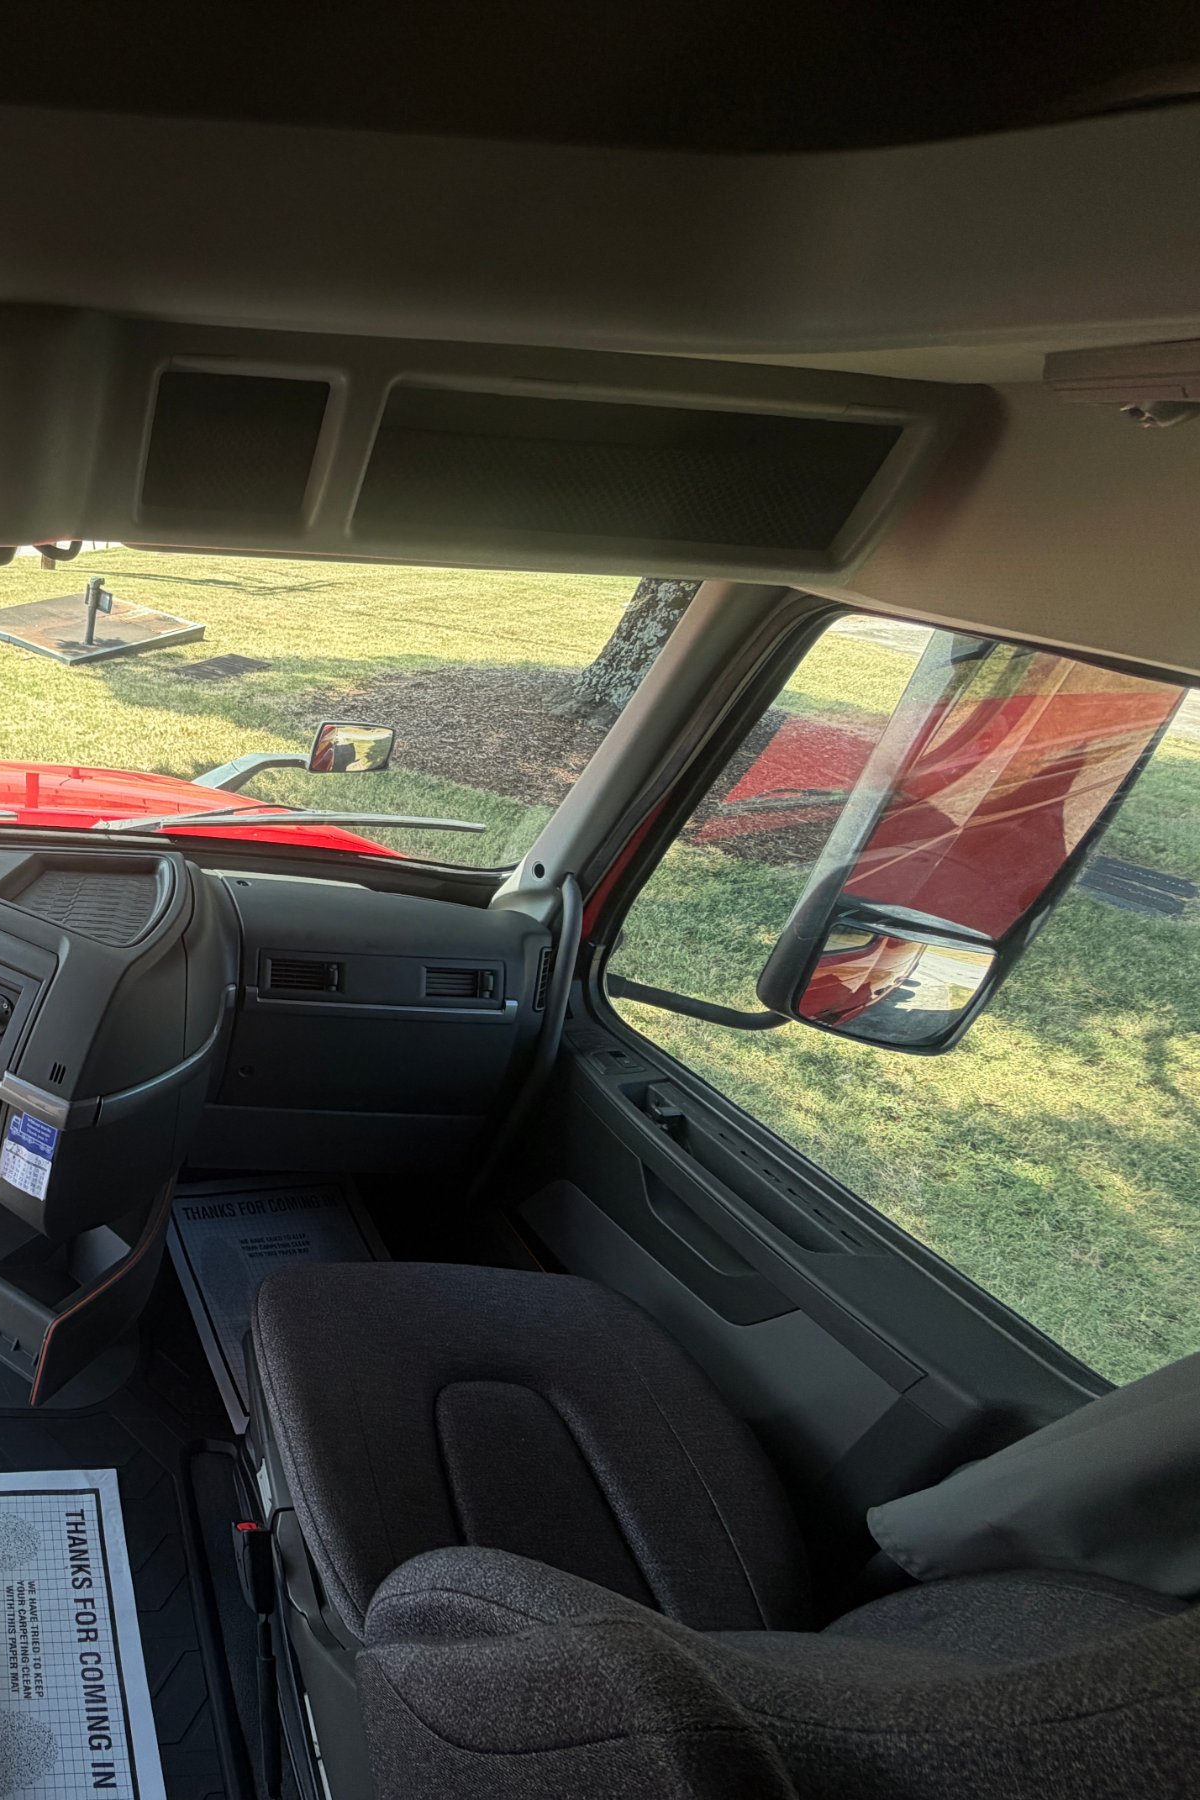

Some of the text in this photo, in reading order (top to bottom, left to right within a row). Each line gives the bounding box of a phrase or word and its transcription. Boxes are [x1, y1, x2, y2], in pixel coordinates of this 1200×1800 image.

[182, 1203, 235, 1220] THANKS
[238, 1200, 266, 1215] FOR
[268, 1195, 320, 1213] COMING
[6, 1586, 20, 1693] WITH THIS PAPER MAT
[17, 1581, 32, 1698] YOUR CARPETING CLEAN
[27, 1581, 44, 1697] WE HAVE TRIED TO KEEP
[65, 1509, 117, 1788] THANKS FOR COMING IN
